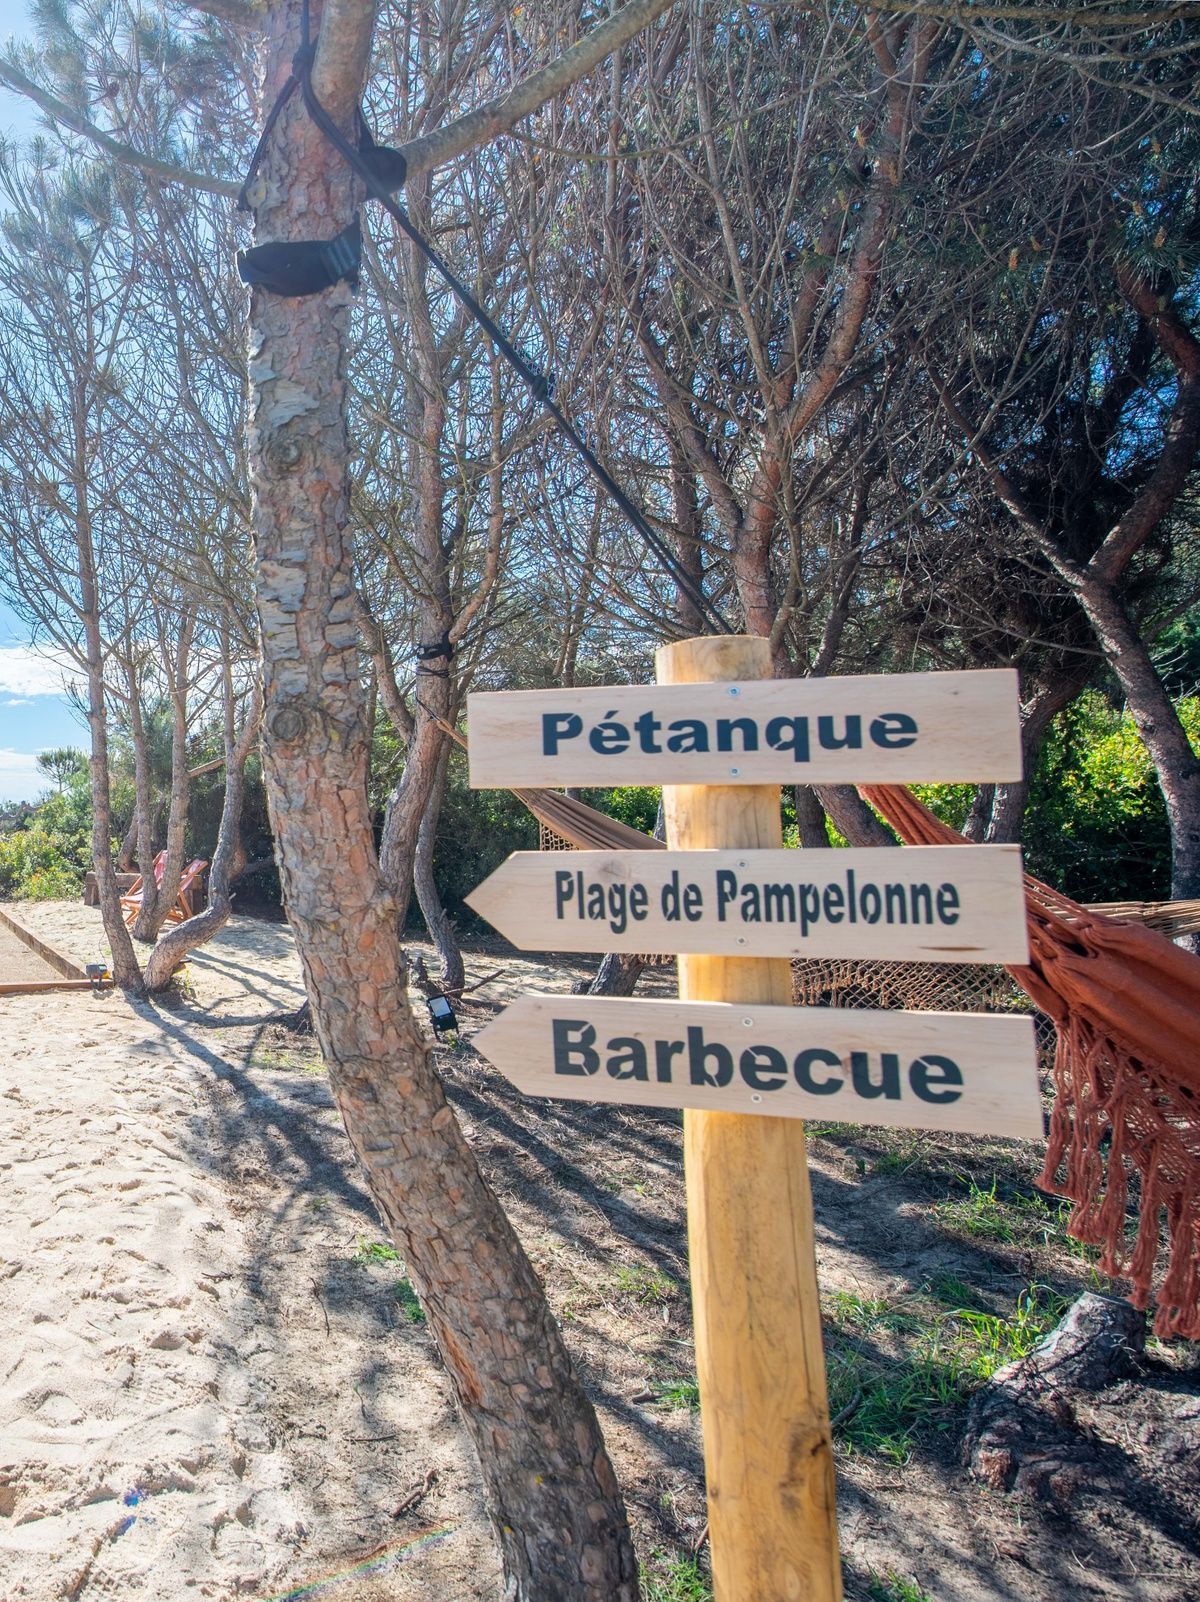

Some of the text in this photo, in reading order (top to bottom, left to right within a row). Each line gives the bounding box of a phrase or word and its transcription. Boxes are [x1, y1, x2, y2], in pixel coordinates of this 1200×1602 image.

[541, 709, 919, 763] Pétanque
[555, 869, 961, 937] Plage de Pampelonne
[551, 1018, 964, 1104] Barbecue
